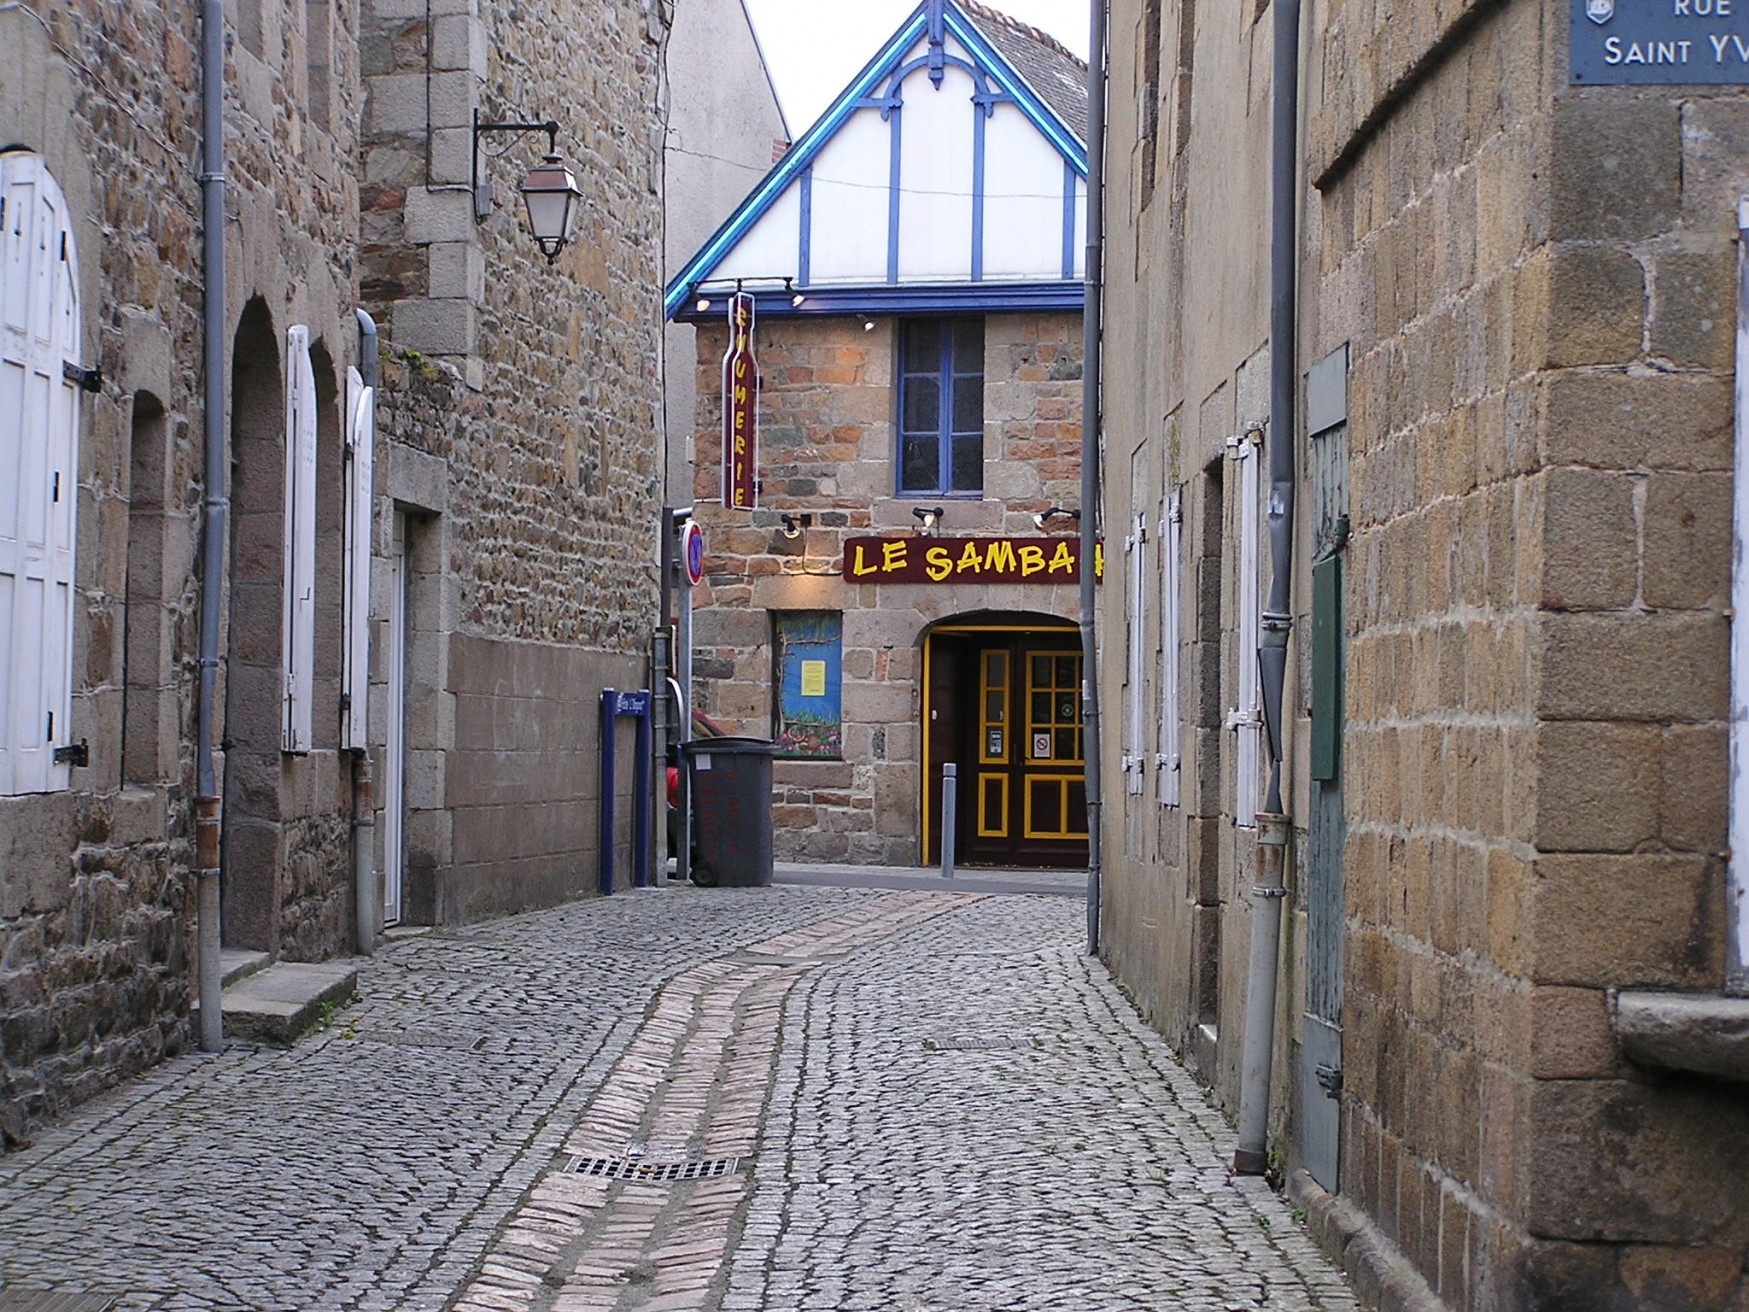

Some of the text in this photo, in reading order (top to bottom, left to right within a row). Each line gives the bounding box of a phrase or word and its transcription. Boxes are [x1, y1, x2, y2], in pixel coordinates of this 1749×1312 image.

[1674, 0, 1731, 15] RUE
[1604, 36, 1692, 64] SAINT
[853, 540, 907, 576] LE
[925, 540, 1075, 581] SAMBA
